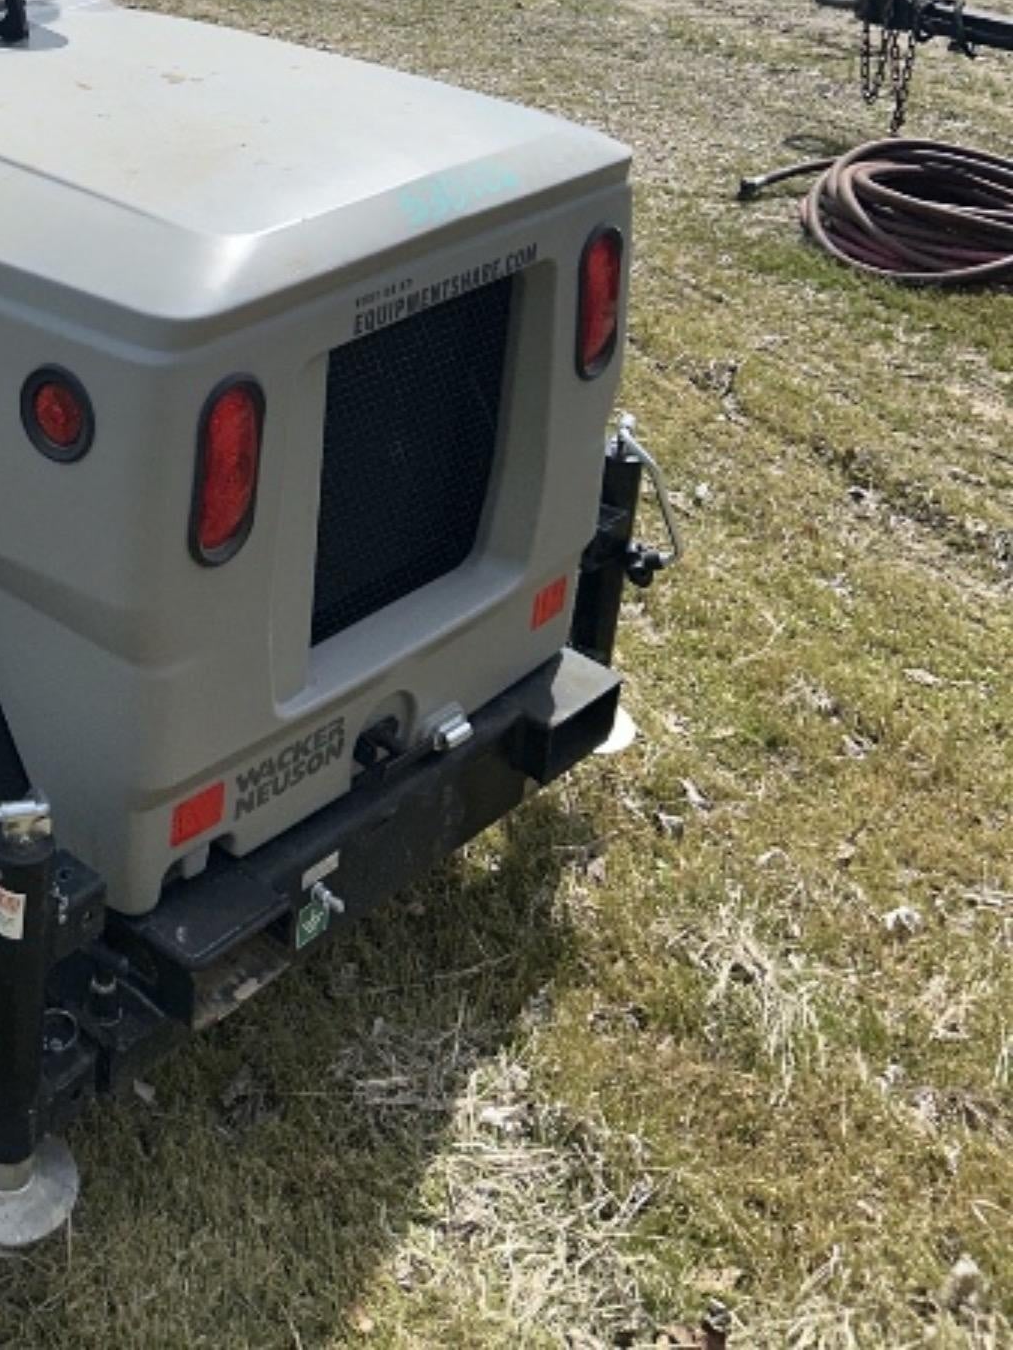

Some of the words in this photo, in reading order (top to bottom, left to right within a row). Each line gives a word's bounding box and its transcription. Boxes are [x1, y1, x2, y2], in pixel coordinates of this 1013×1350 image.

[353, 242, 539, 337] EQUIPMENTSHARE.COM
[234, 733, 345, 821] NEUSON
[235, 715, 345, 792] WACKER
